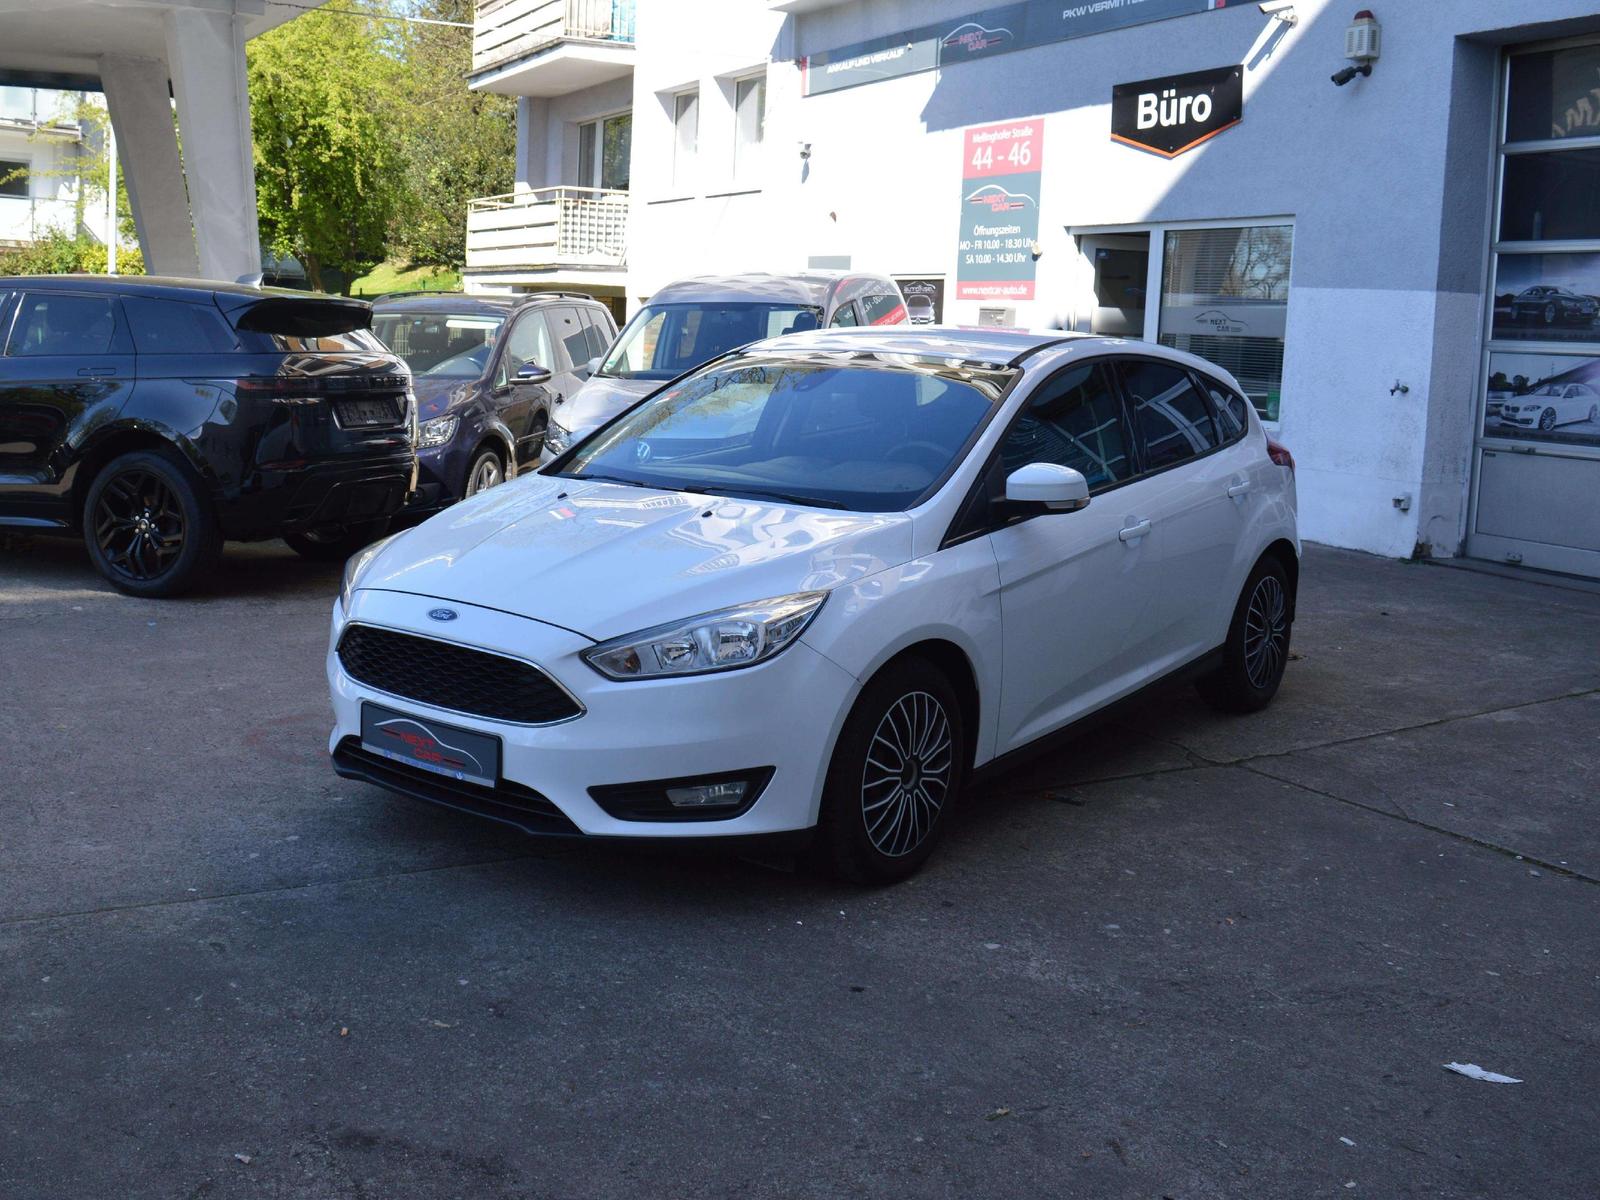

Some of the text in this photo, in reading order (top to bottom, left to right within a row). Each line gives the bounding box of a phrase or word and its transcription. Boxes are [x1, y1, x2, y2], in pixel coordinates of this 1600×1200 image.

[1062, 0, 1145, 20] PKW VERMITT
[1137, 89, 1212, 130] Büro
[971, 145, 993, 170] 44
[1008, 140, 1032, 167] 46
[973, 224, 1021, 237] Öffnungszeiten
[960, 240, 971, 250] MO
[974, 239, 984, 250] FR
[966, 254, 974, 264] SA
[1014, 252, 1027, 263] Uhr
[962, 284, 1028, 296] www.nextcar-auto.de
[431, 610, 453, 620] Ford
